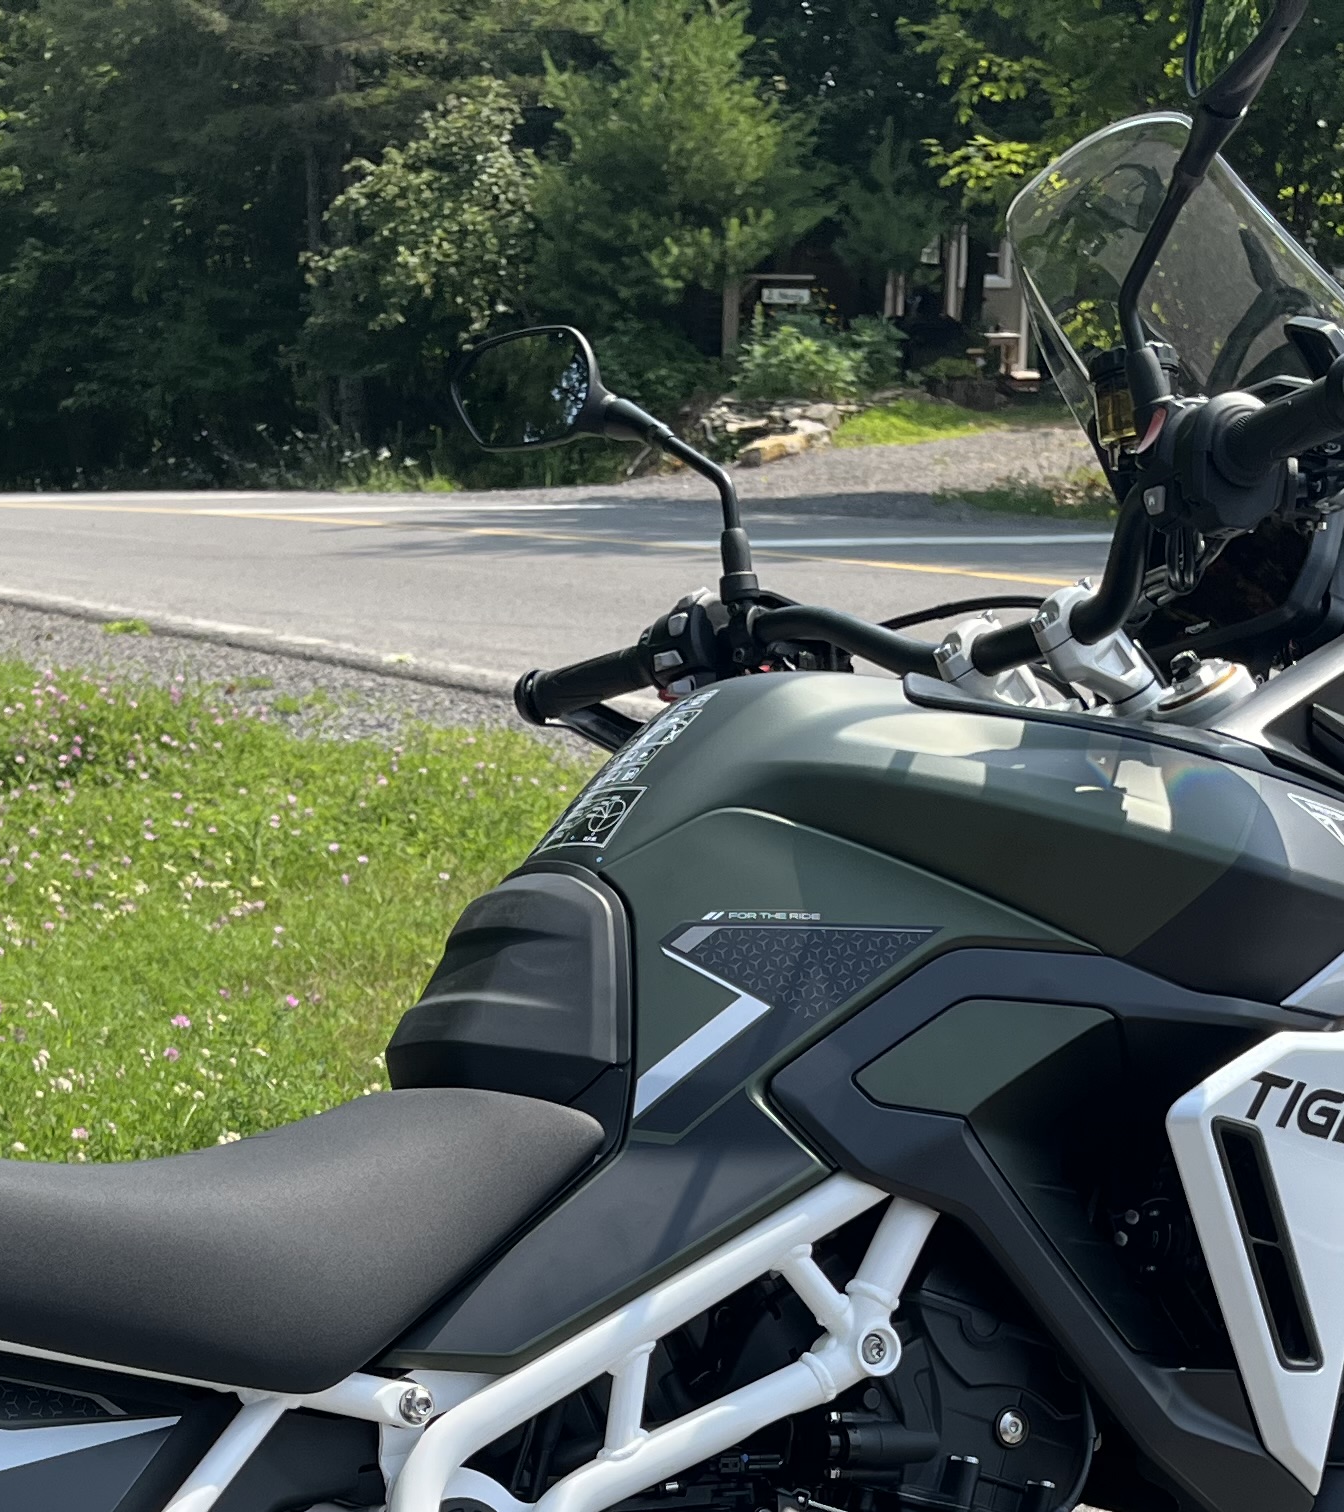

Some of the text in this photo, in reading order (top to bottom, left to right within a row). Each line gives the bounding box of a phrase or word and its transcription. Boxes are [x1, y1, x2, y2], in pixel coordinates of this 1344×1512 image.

[728, 912, 821, 921] FOR THE RIDE
